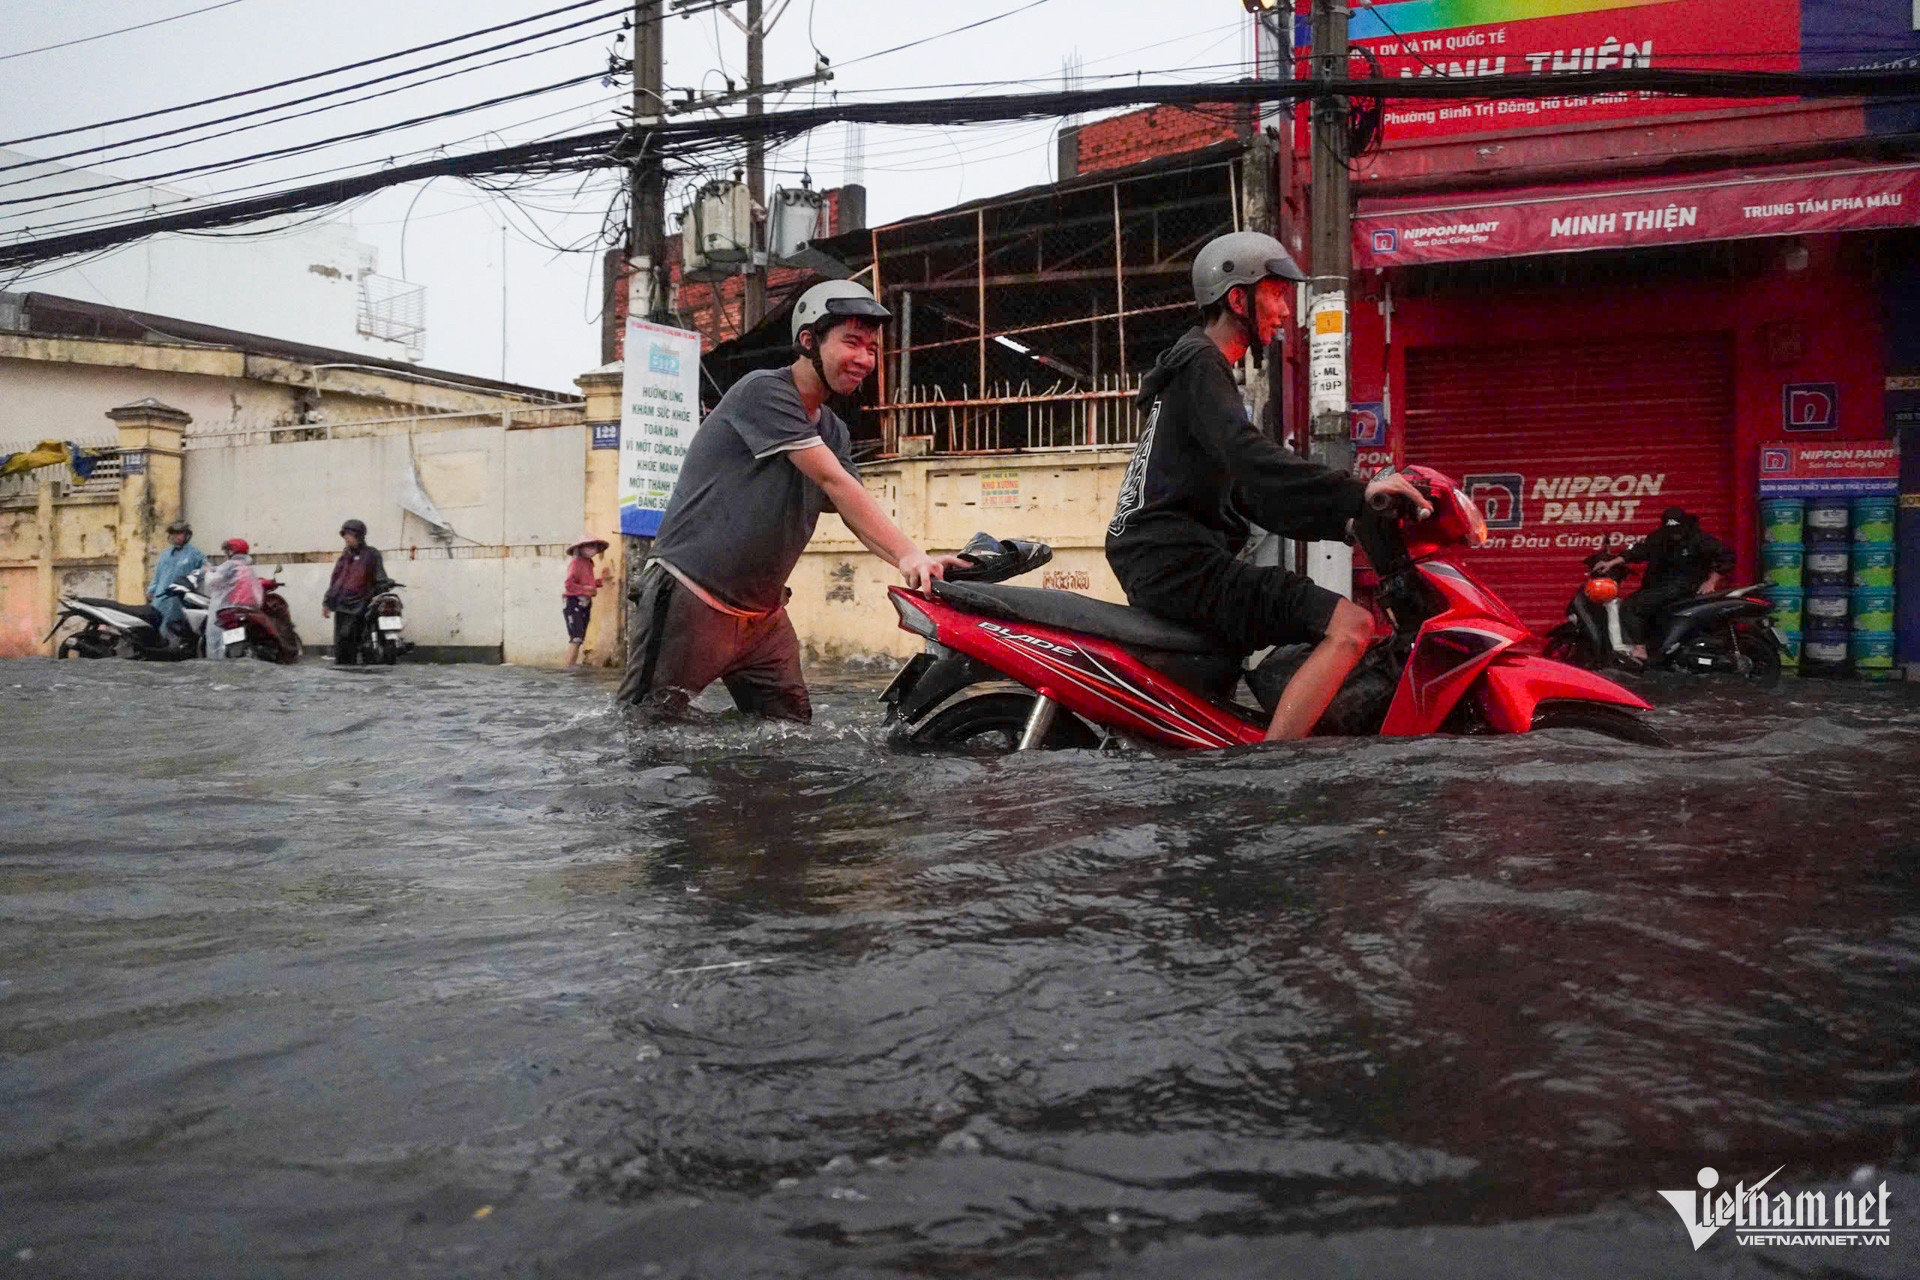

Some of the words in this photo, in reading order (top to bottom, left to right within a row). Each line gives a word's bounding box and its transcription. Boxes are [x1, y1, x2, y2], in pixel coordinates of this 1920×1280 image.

[1421, 38, 1442, 51] TM
[1446, 30, 1485, 50] QUỐC
[1487, 27, 1506, 44] TẾ
[1384, 110, 1436, 125] Phường
[1743, 202, 1795, 219] TRUNG
[1797, 198, 1829, 214] TÂM
[1831, 197, 1864, 211] PHA
[1403, 224, 1458, 240] NIPPON
[1458, 221, 1500, 234] PAINT
[1550, 212, 1617, 238] MINH
[1622, 203, 1698, 233] THIỆN
[595, 426, 617, 438] 122
[1800, 450, 1853, 460] NIPPON
[1855, 449, 1895, 459] PAINT
[1531, 473, 1665, 500] NIPPON
[1540, 499, 1641, 524] PAINT
[1470, 535, 1507, 549] ơn
[1555, 530, 1605, 550] Cũng
[977, 621, 1078, 657] BLADE
